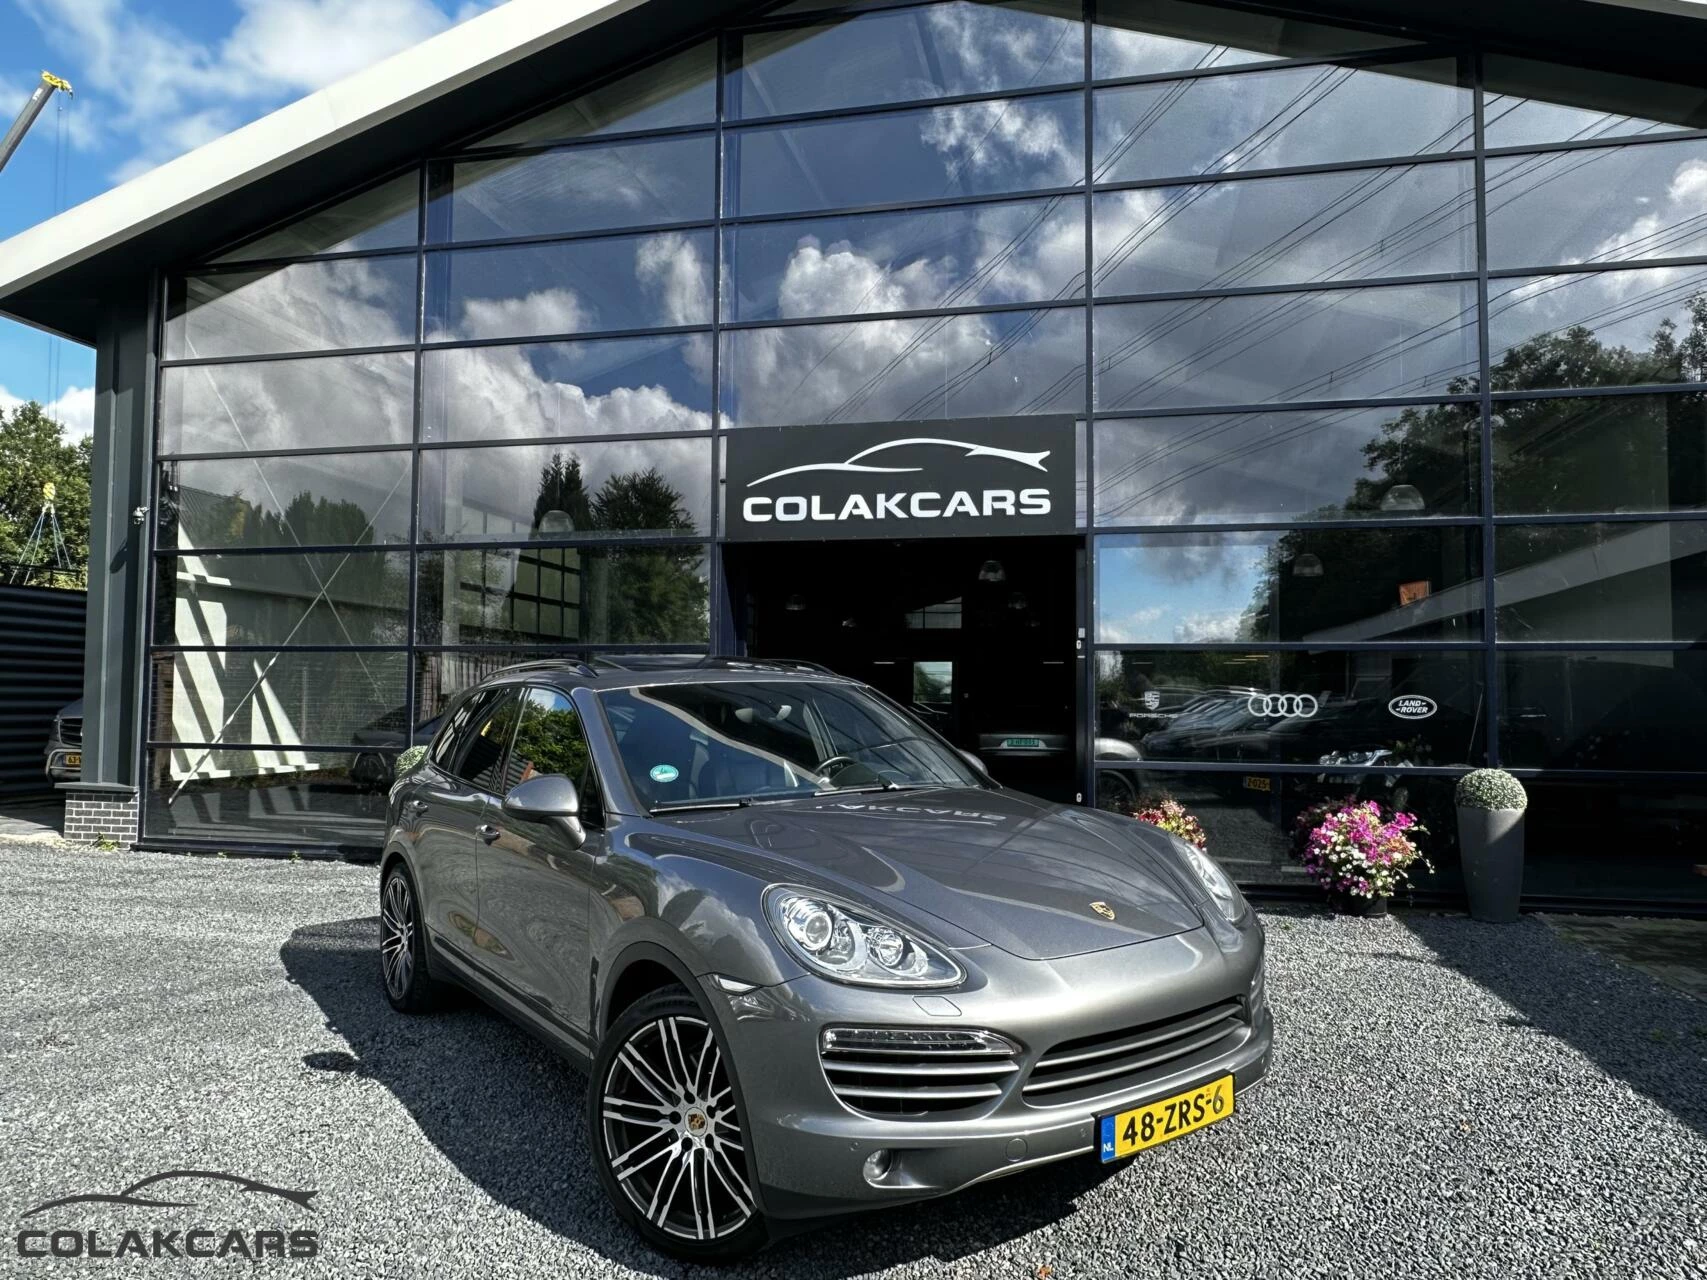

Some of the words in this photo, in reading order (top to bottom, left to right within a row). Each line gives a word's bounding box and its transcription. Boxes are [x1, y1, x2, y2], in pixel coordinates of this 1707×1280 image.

[743, 488, 1051, 522] COLAKCARS
[1122, 1084, 1225, 1147] 48-ZRS-6
[1103, 1142, 1114, 1153] NL
